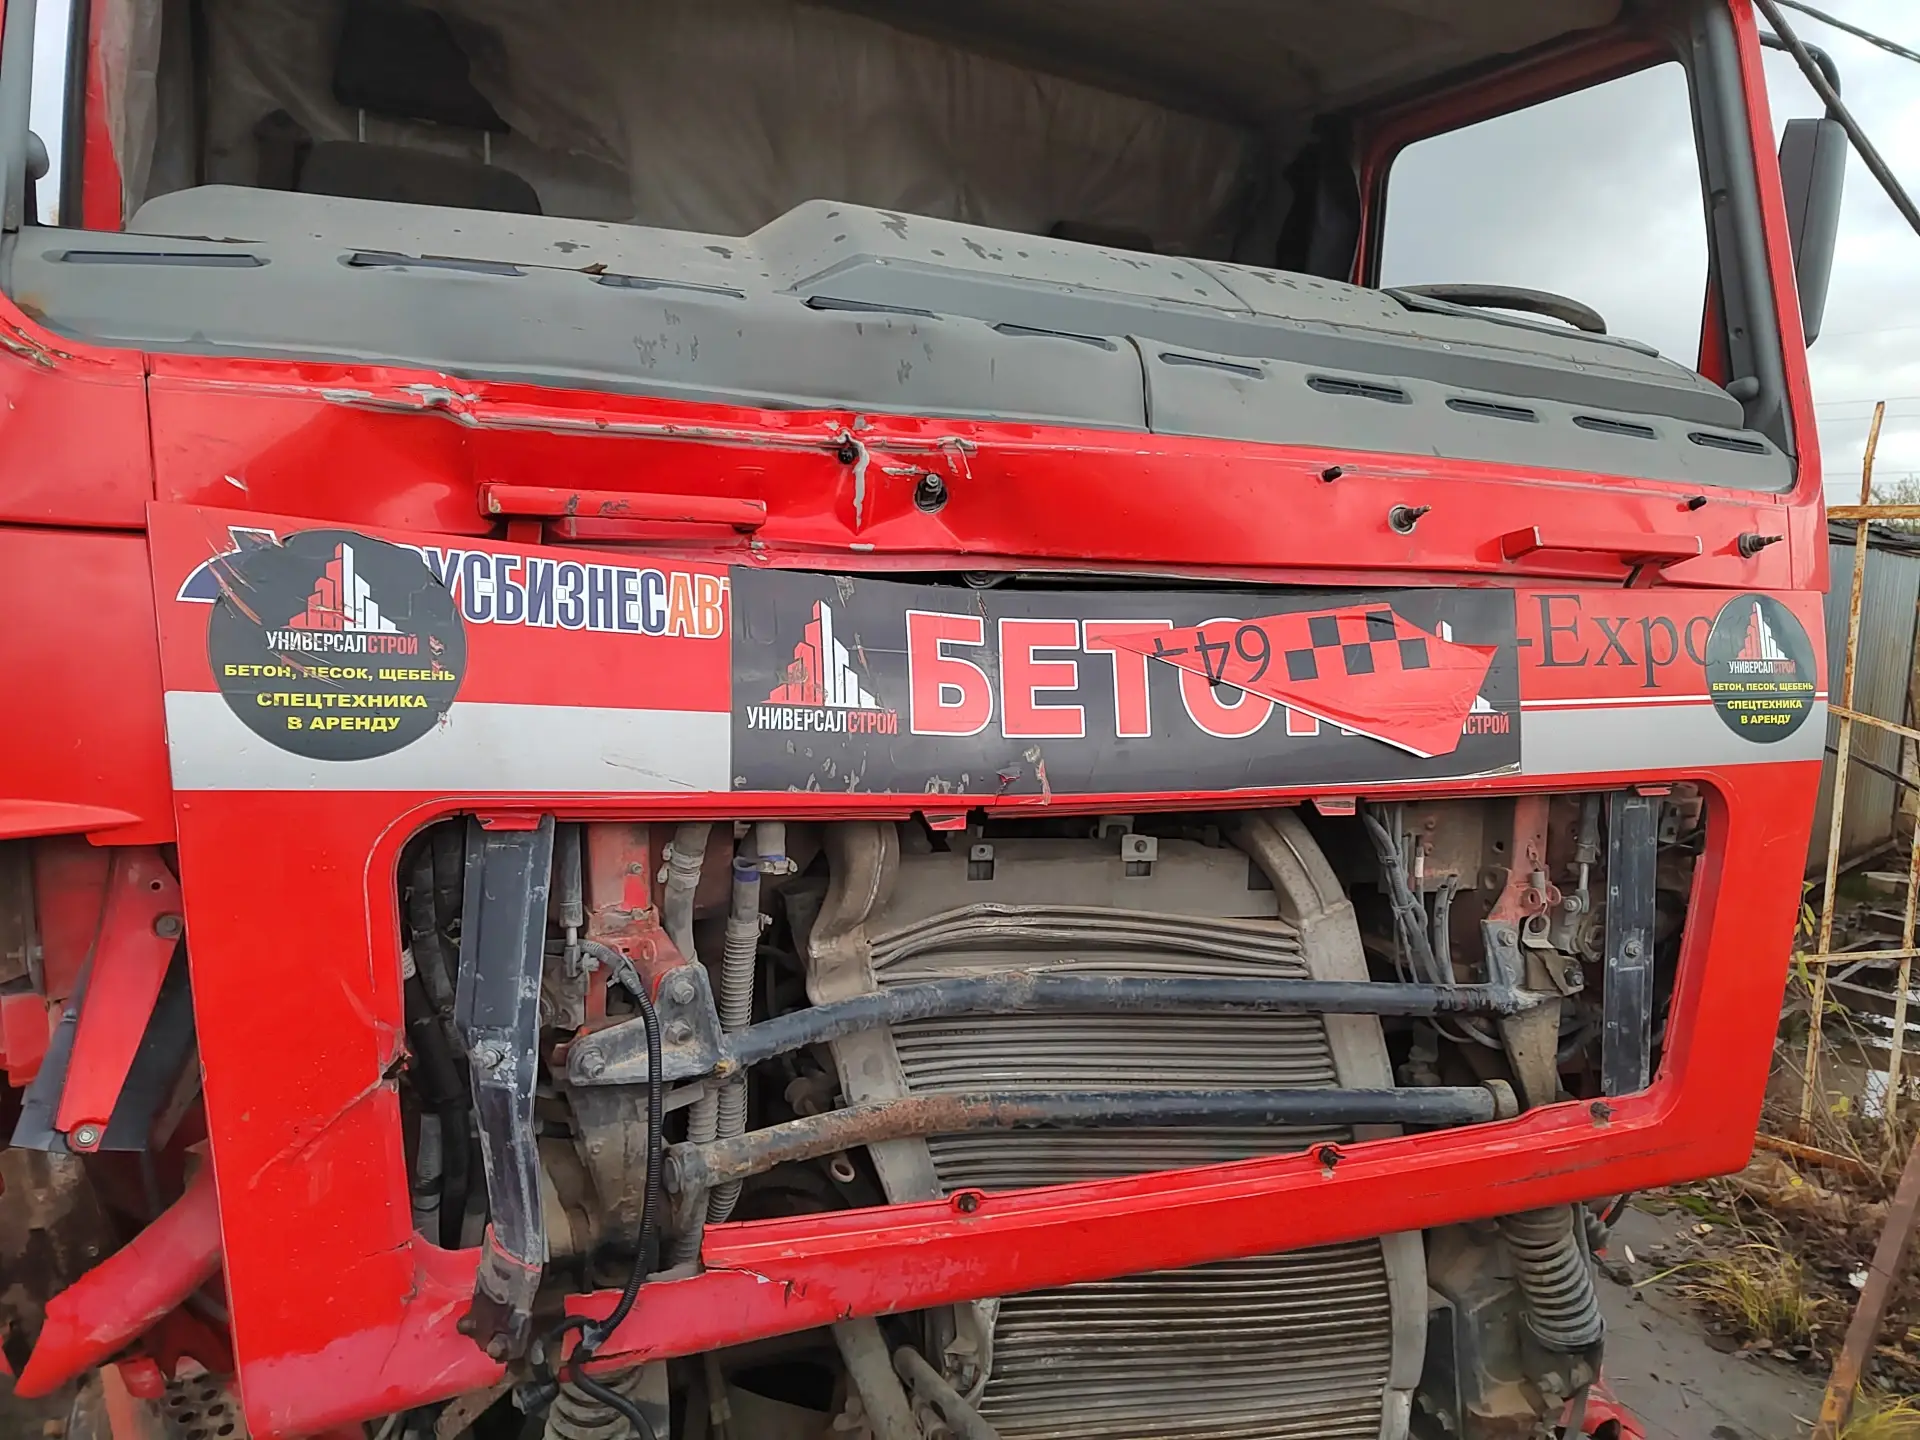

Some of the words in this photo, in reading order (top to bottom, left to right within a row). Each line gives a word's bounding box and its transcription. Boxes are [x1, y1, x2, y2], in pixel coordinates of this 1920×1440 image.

[403, 545, 731, 639] УСБИЗНЕСАВ
[266, 631, 419, 655] УНИВЕРСАЛСТРОЙ
[224, 664, 297, 681] БЕТОН,
[303, 666, 373, 682] ПЕСОК,
[379, 668, 456, 682] ЩЕБЕНЬ
[906, 609, 1360, 739] БЕТО
[1728, 660, 1796, 674] УНИВЕРСАЛСТРОЙ
[1712, 682, 1744, 692] БЕТОН,
[1746, 683, 1777, 692] ПЕСОК,
[1779, 682, 1814, 691] ЩЕБЕНЬ
[256, 693, 428, 710] СПЕЦТЕХНИКА
[1727, 700, 1803, 710] СПЕЦТЕХНИКА
[287, 716, 303, 730] В
[309, 717, 401, 732] АРЕНДУ
[746, 706, 898, 735] УНИВЕРСАЛСТРОЙ
[1740, 715, 1748, 724] В
[1751, 714, 1791, 725] АРЕНДУ
